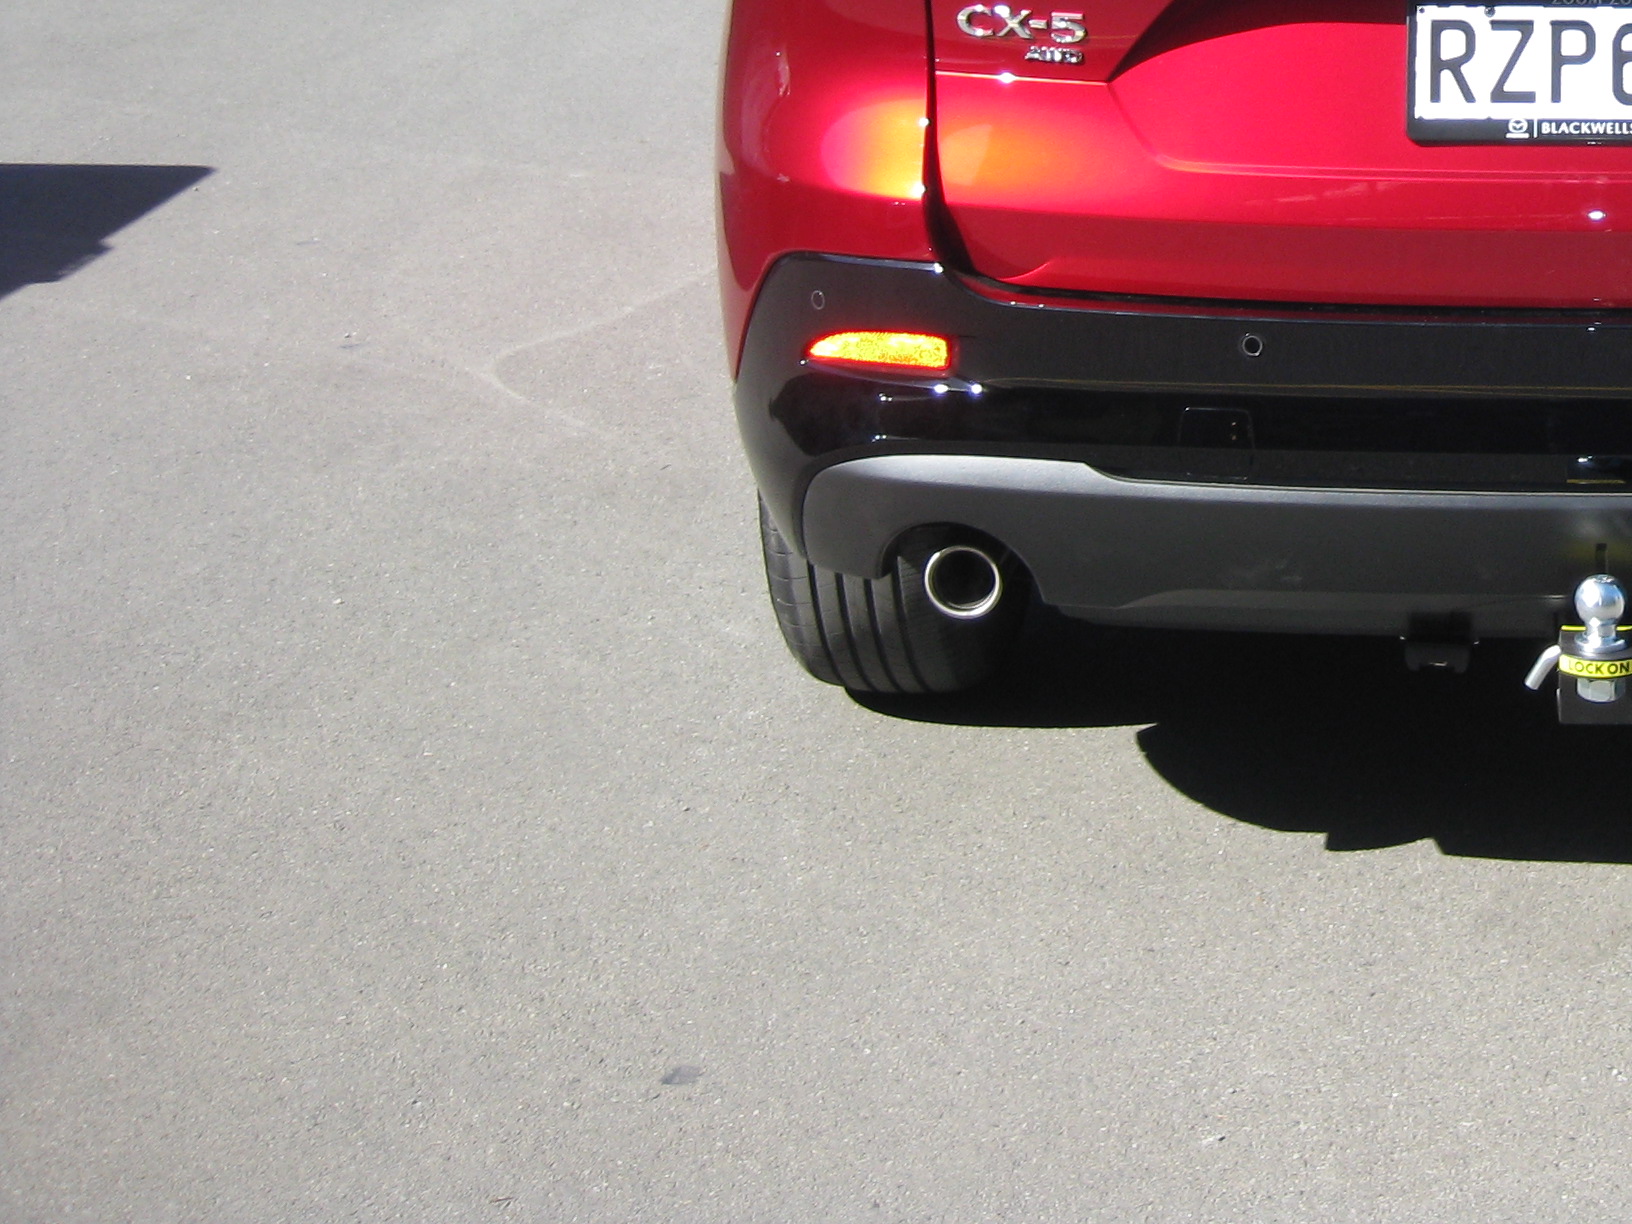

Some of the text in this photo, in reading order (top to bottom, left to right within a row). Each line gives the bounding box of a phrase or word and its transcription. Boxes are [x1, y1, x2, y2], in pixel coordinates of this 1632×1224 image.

[956, 4, 1086, 43] CX-5
[1568, 661, 1630, 675] LOCK ON
